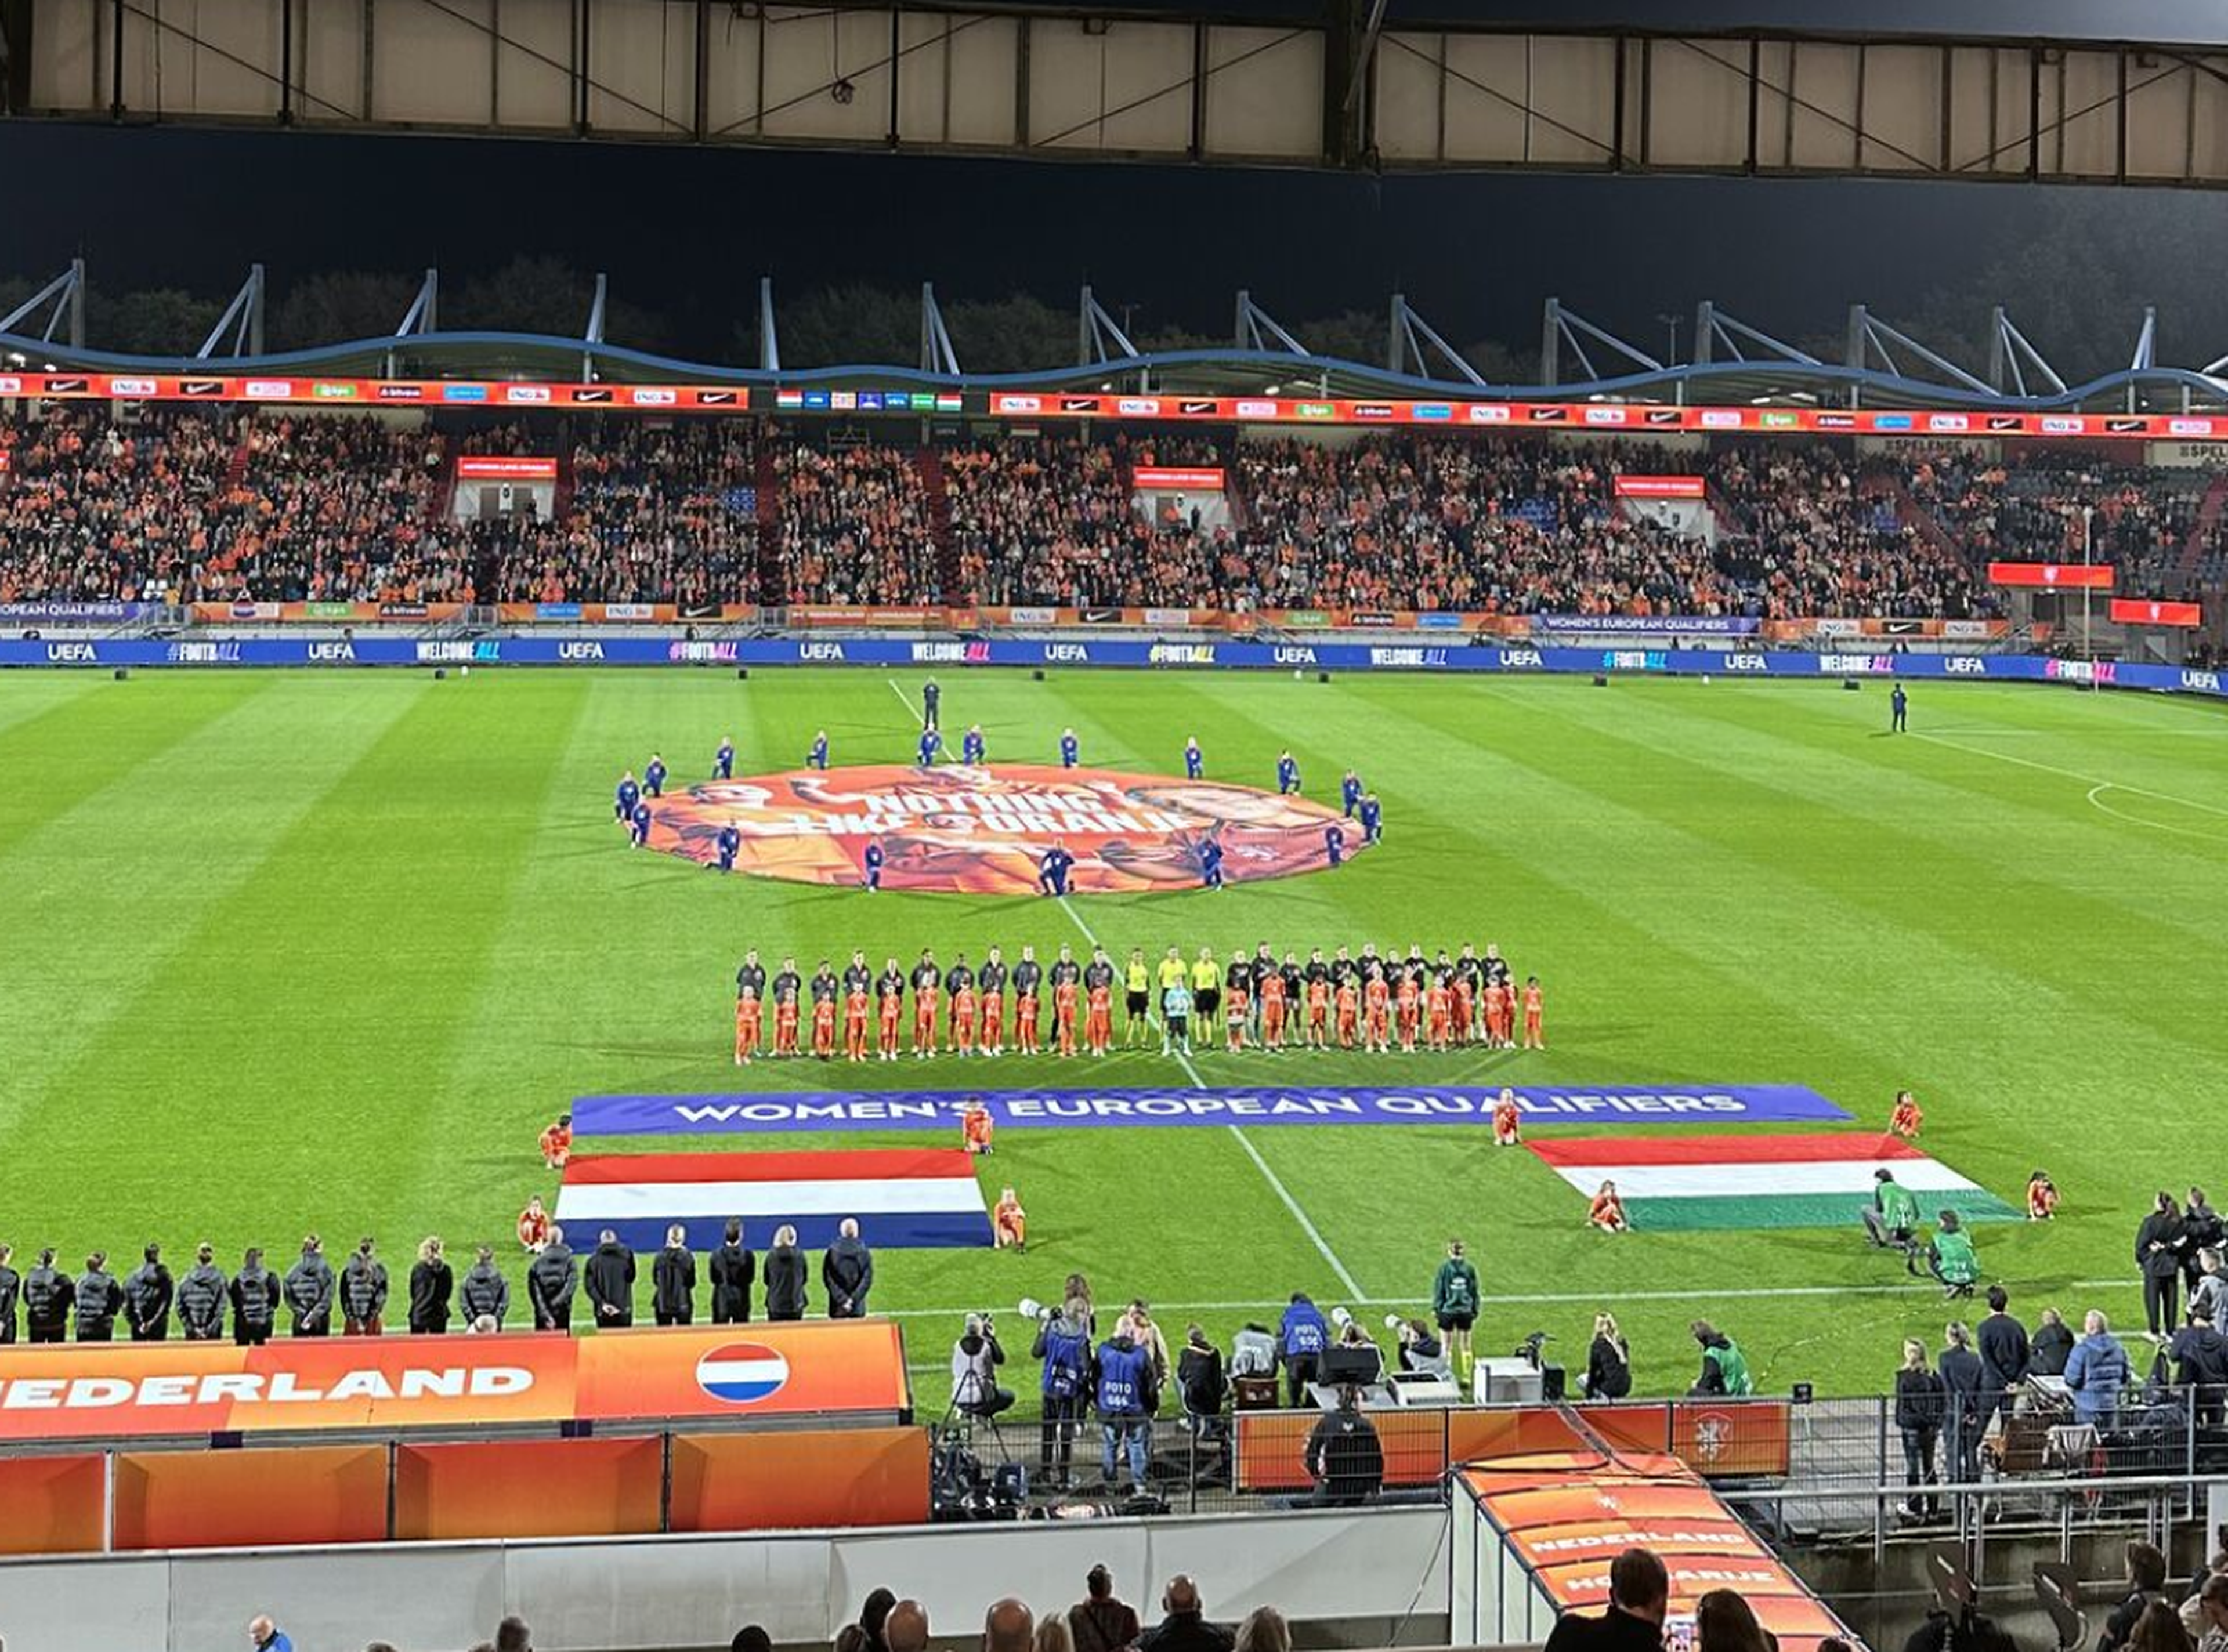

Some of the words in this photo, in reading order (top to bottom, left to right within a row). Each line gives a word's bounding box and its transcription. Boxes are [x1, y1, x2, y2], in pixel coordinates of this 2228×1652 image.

[608, 604, 632, 616] ING
[1547, 618, 1600, 628] WOMEN'S
[1603, 618, 1663, 630] EUROPEAN
[1665, 619, 1730, 630] QUALIFIERS
[48, 644, 96, 660] UEFA
[308, 643, 355, 659] UEFA
[559, 643, 605, 658] UEFA
[800, 644, 844, 659] UEFA
[1045, 644, 1088, 661] UEFA
[1274, 647, 1316, 663] UEFA
[1500, 651, 1542, 665] UEFA
[1724, 654, 1767, 669] UEFA
[1945, 657, 1984, 672] UEFA
[2182, 672, 2220, 690] UEFA
[864, 794, 1111, 813] NOTHING
[1007, 1097, 1362, 1117] EUROPEAN
[0, 1367, 533, 1410] EDERLAND
[1530, 1533, 1745, 1552] NEDERLAND
[1567, 1571, 1774, 1590] HOARIJE
